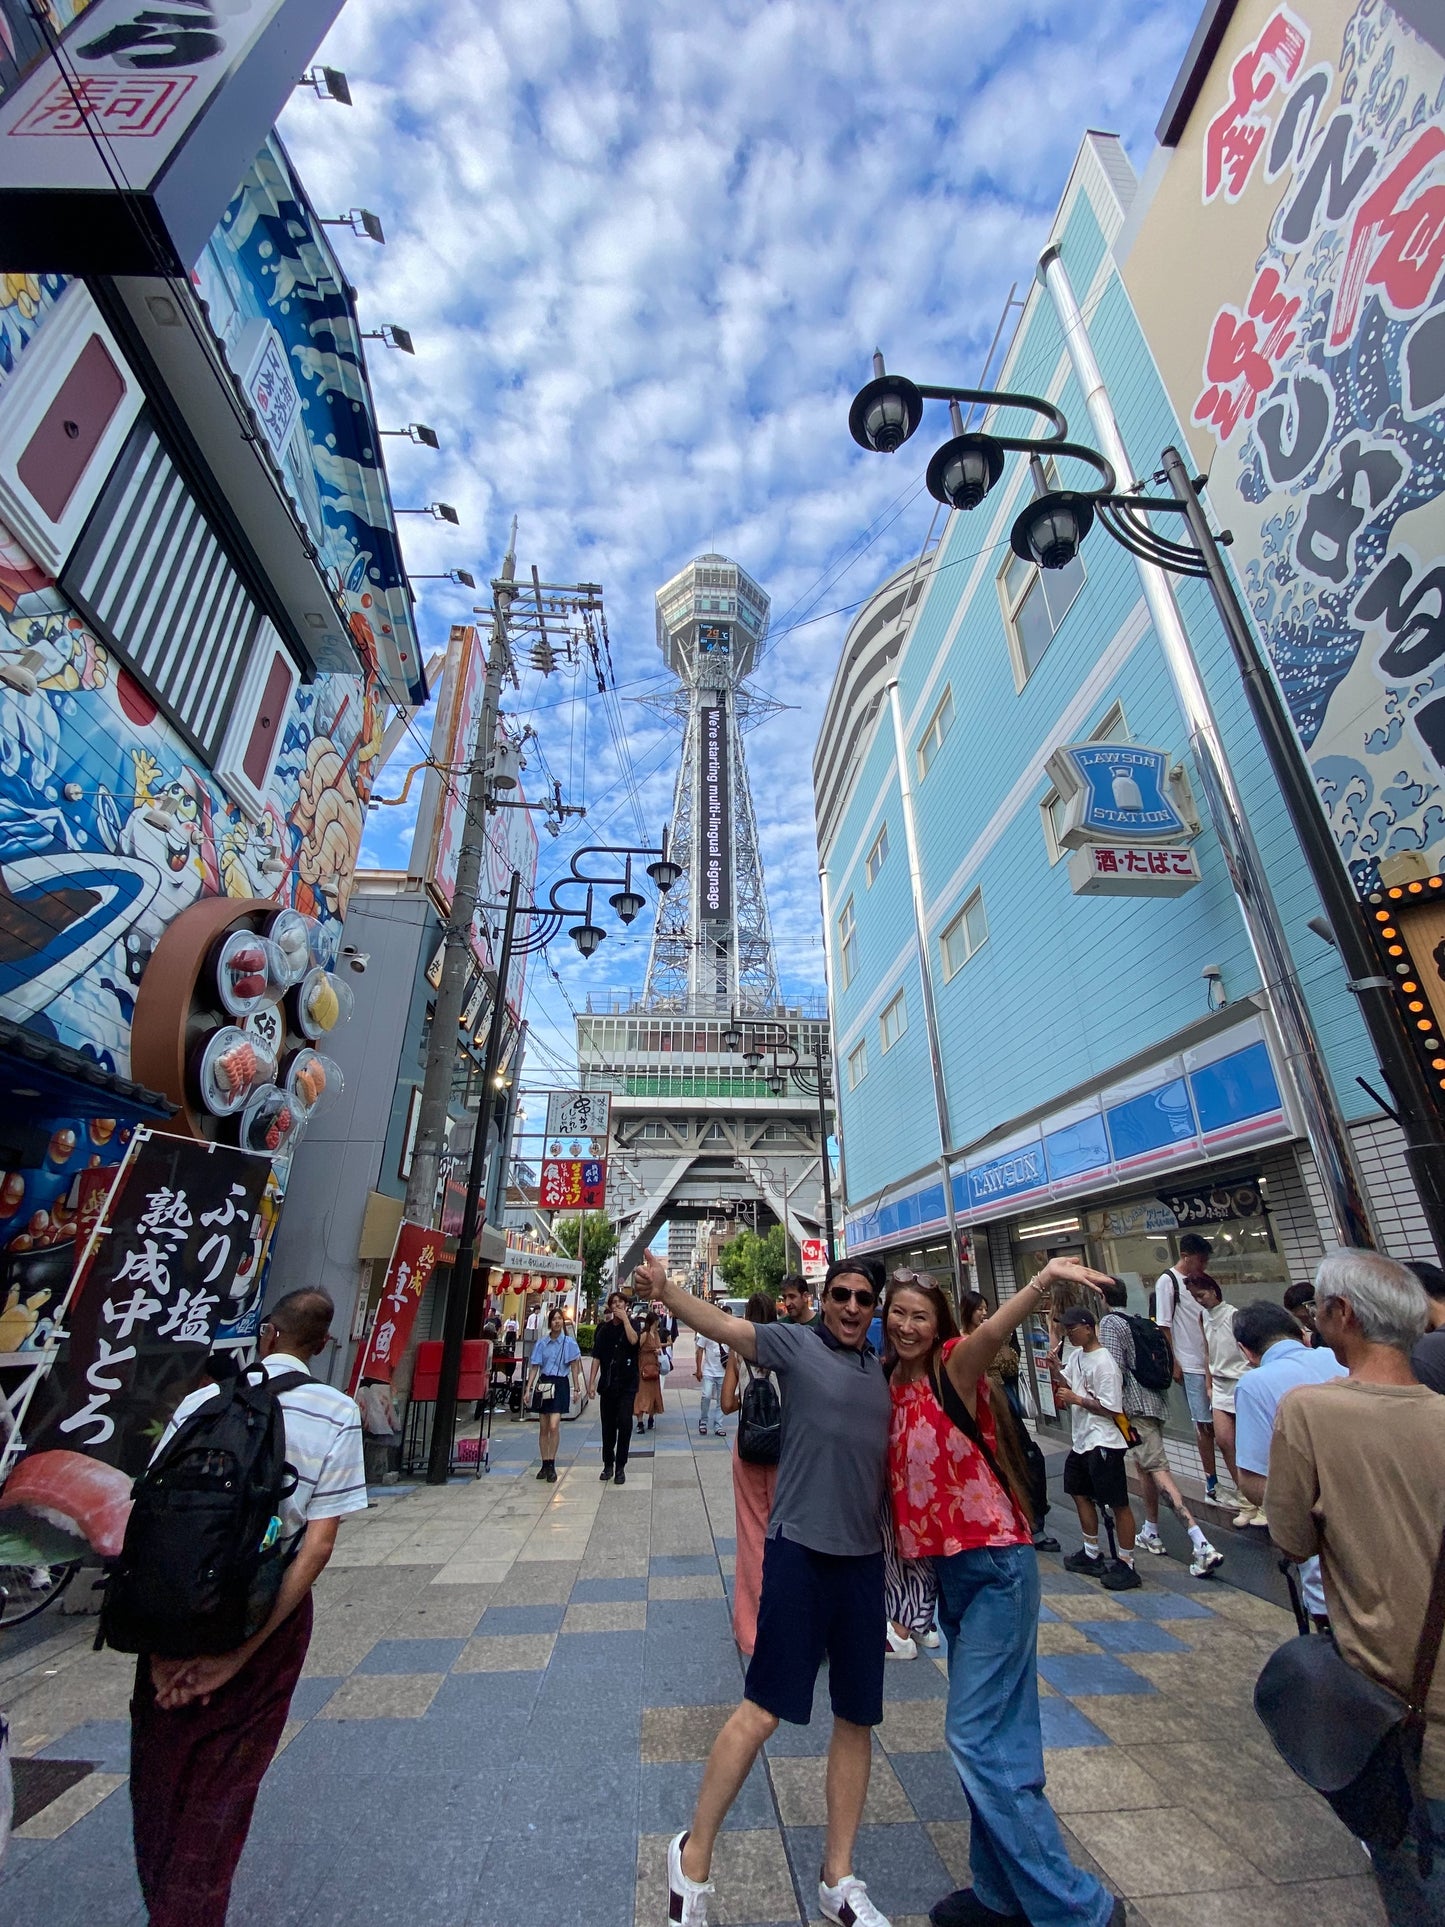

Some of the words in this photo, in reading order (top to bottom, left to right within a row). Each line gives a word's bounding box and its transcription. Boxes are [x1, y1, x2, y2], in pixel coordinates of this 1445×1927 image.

[30, 78, 178, 130] 寿司
[708, 710, 721, 738] We're
[706, 741, 721, 782] starting
[1080, 752, 1155, 768] LAWSON
[706, 784, 721, 856] multi-lingual
[1094, 807, 1172, 823] STATION
[706, 860, 721, 909] signage
[254, 1012, 276, 1040] くら
[573, 1094, 591, 1131] 串かつ
[973, 1151, 1040, 1198] LAWSON
[158, 1182, 250, 1346] ふり塩
[407, 1244, 436, 1297] 熟成
[803, 1240, 822, 1259] くすり
[59, 1185, 192, 1446] 熟成中とろ
